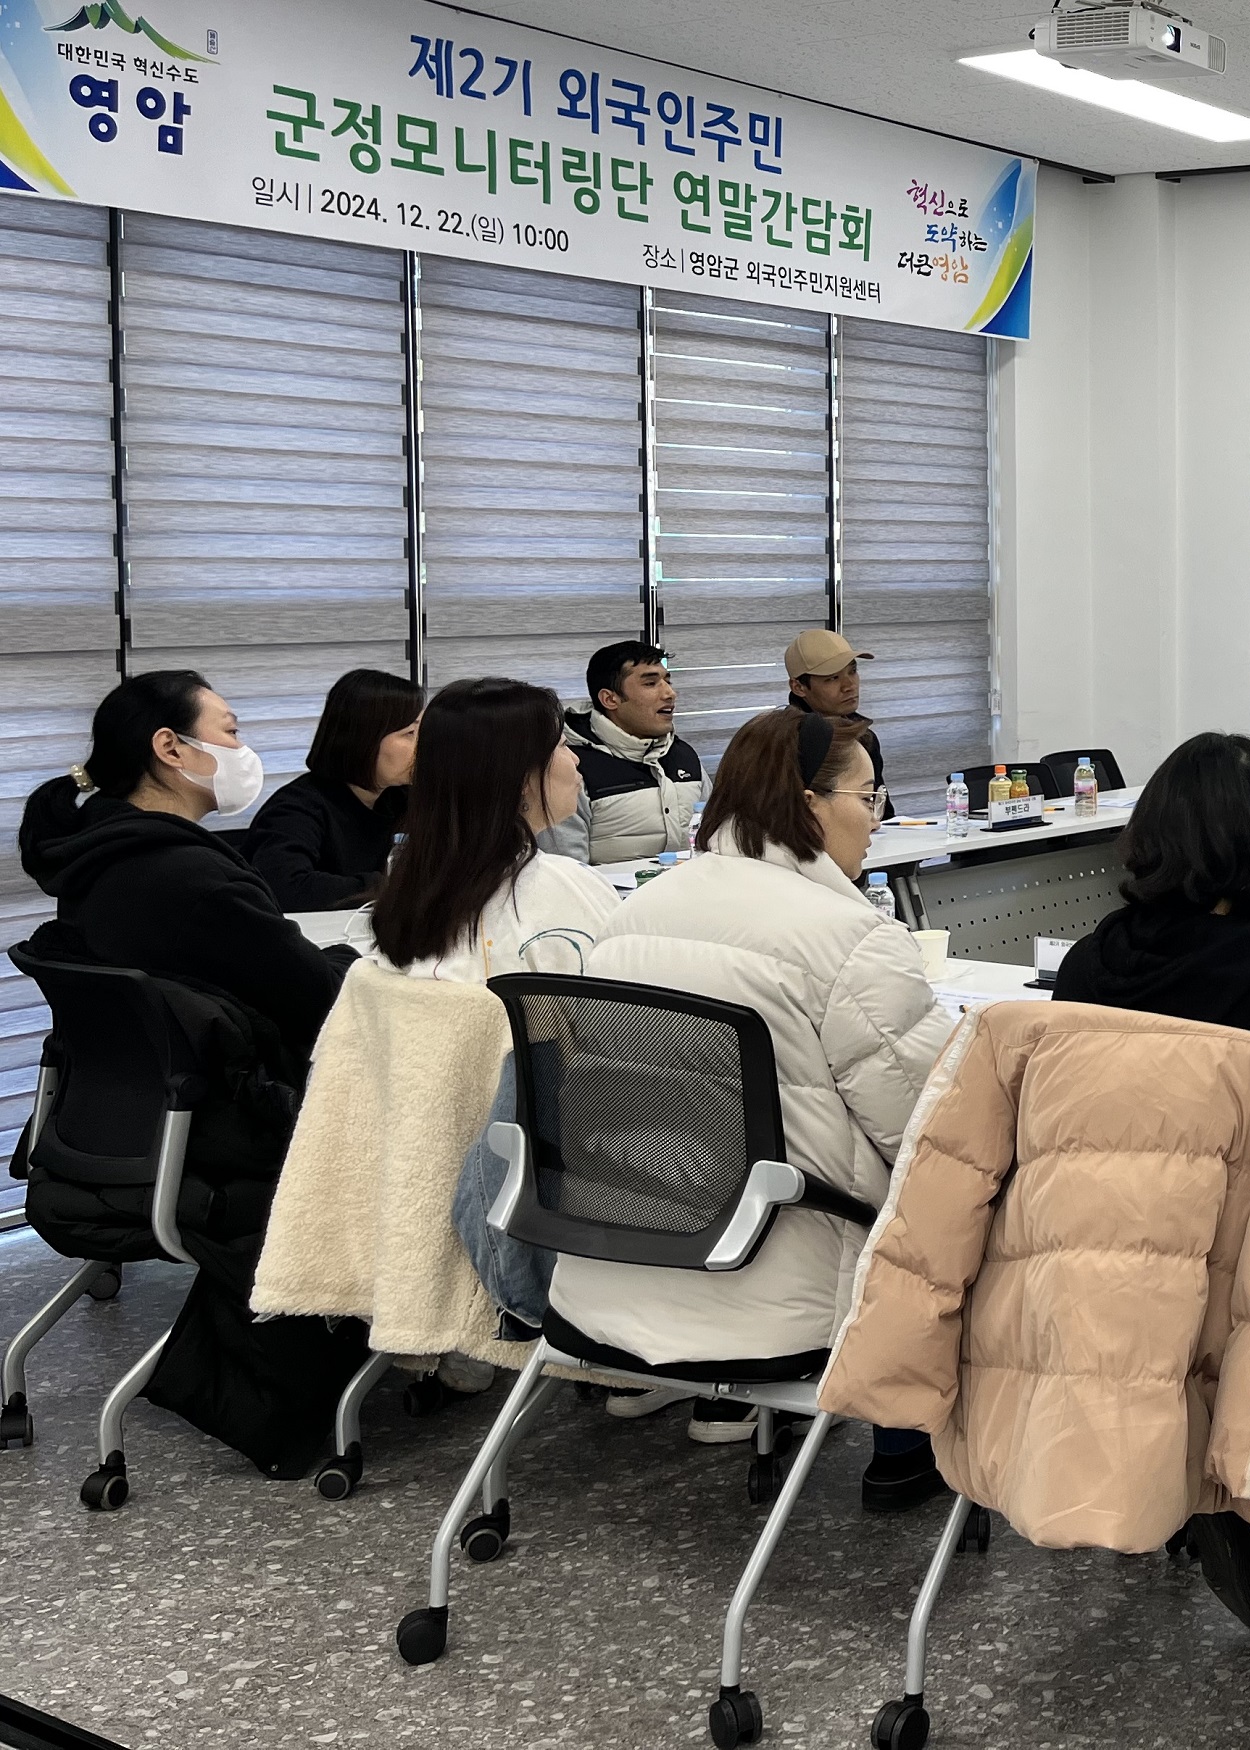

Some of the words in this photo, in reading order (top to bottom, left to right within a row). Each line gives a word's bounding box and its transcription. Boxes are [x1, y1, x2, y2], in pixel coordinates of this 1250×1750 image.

[57, 42, 127, 71] 대한민국
[133, 56, 199, 84] 혁신수도
[69, 74, 192, 156] 영암
[409, 34, 533, 117] 제2기
[557, 69, 784, 175] 외국인주민
[266, 84, 653, 223] 군정모니터링단
[673, 169, 873, 262] 연말간담회
[906, 179, 969, 218] 혁신으로
[252, 177, 299, 211] 일시
[320, 188, 388, 223] 2024.
[397, 203, 430, 230] 12.
[438, 209, 505, 244] 22.(일)
[513, 223, 570, 252] 10:00
[925, 222, 988, 252] 도약하는
[642, 243, 678, 270] 장소
[689, 250, 740, 281] 영암군
[746, 261, 881, 304] 외국인주민지원센터
